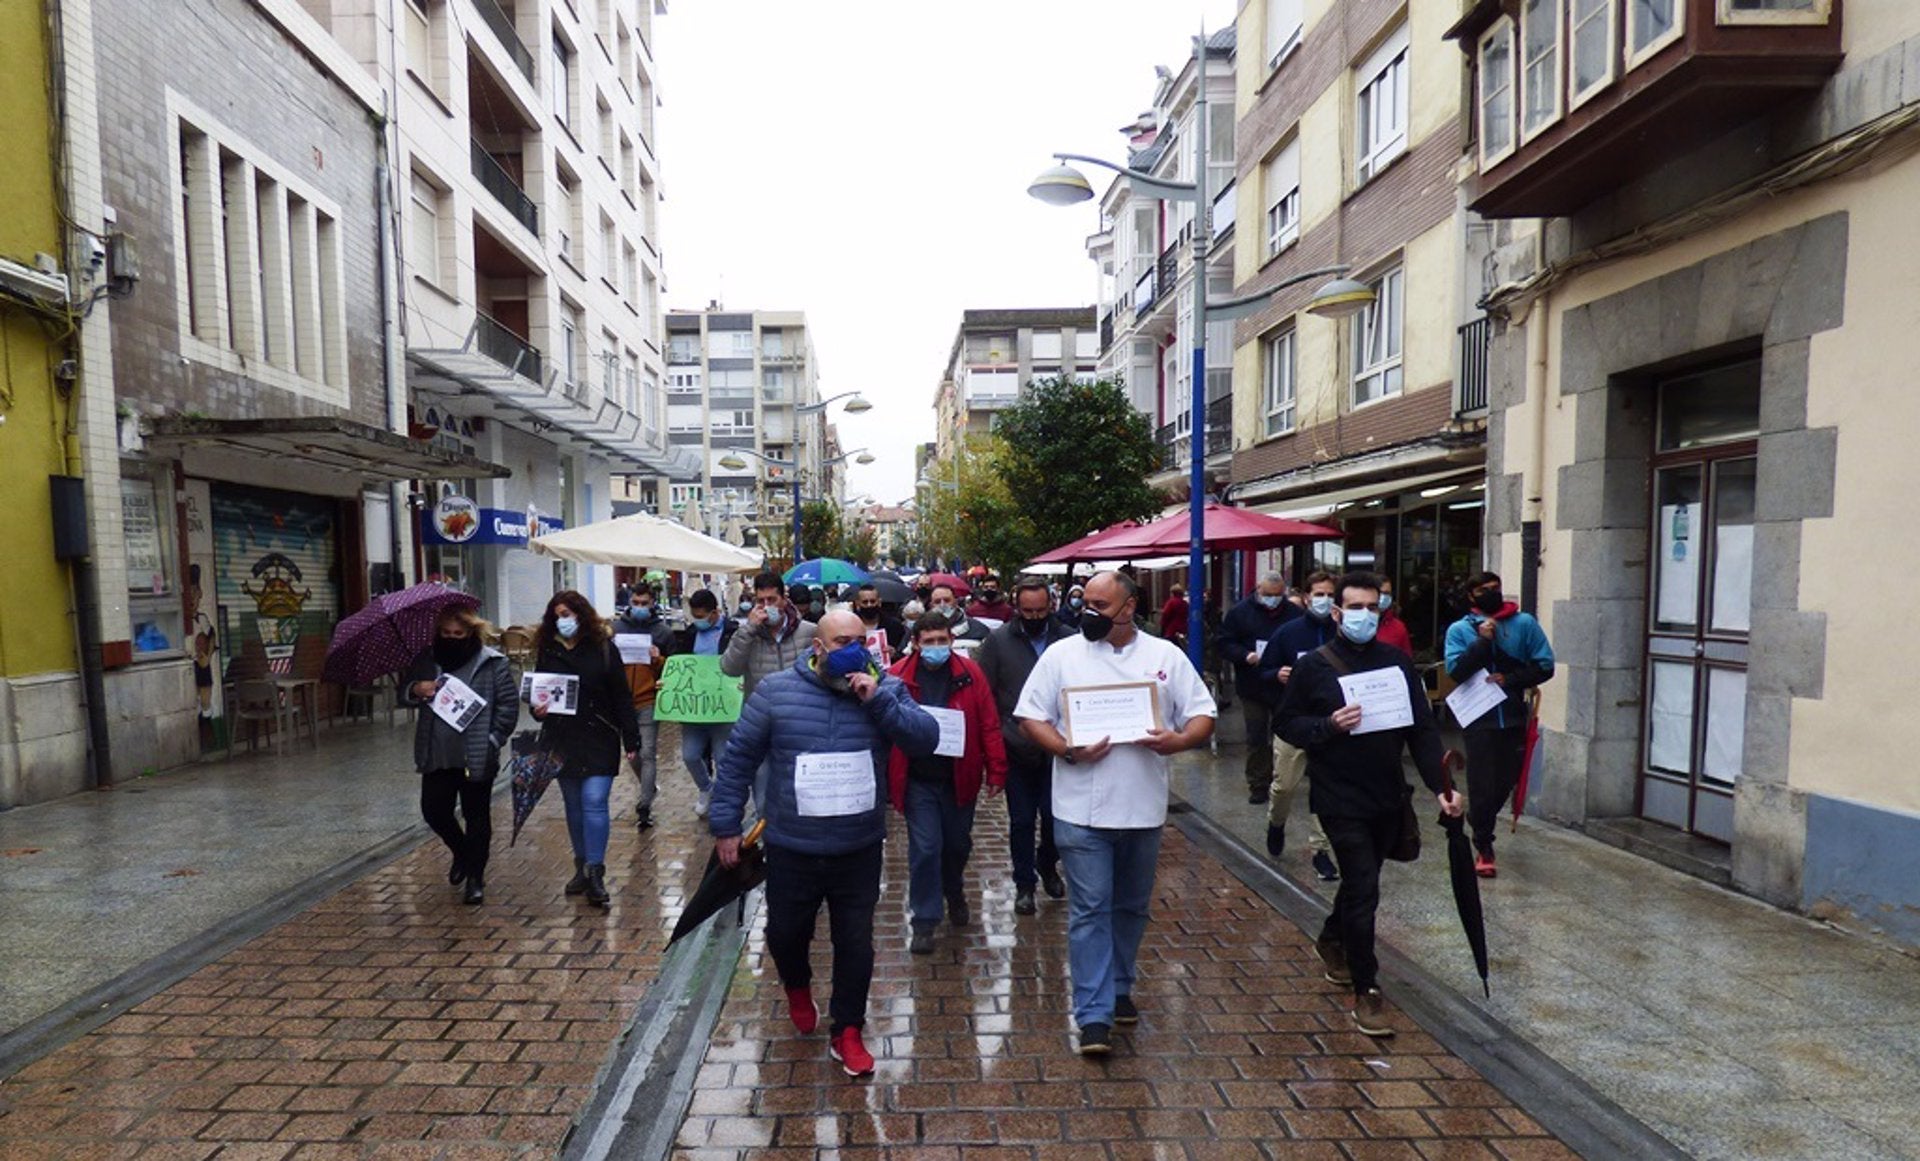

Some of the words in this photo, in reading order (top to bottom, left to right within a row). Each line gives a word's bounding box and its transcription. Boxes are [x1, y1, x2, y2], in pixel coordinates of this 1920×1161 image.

[664, 658, 698, 678] BAR
[672, 676, 695, 692] LA
[659, 690, 729, 715] CANTINA
